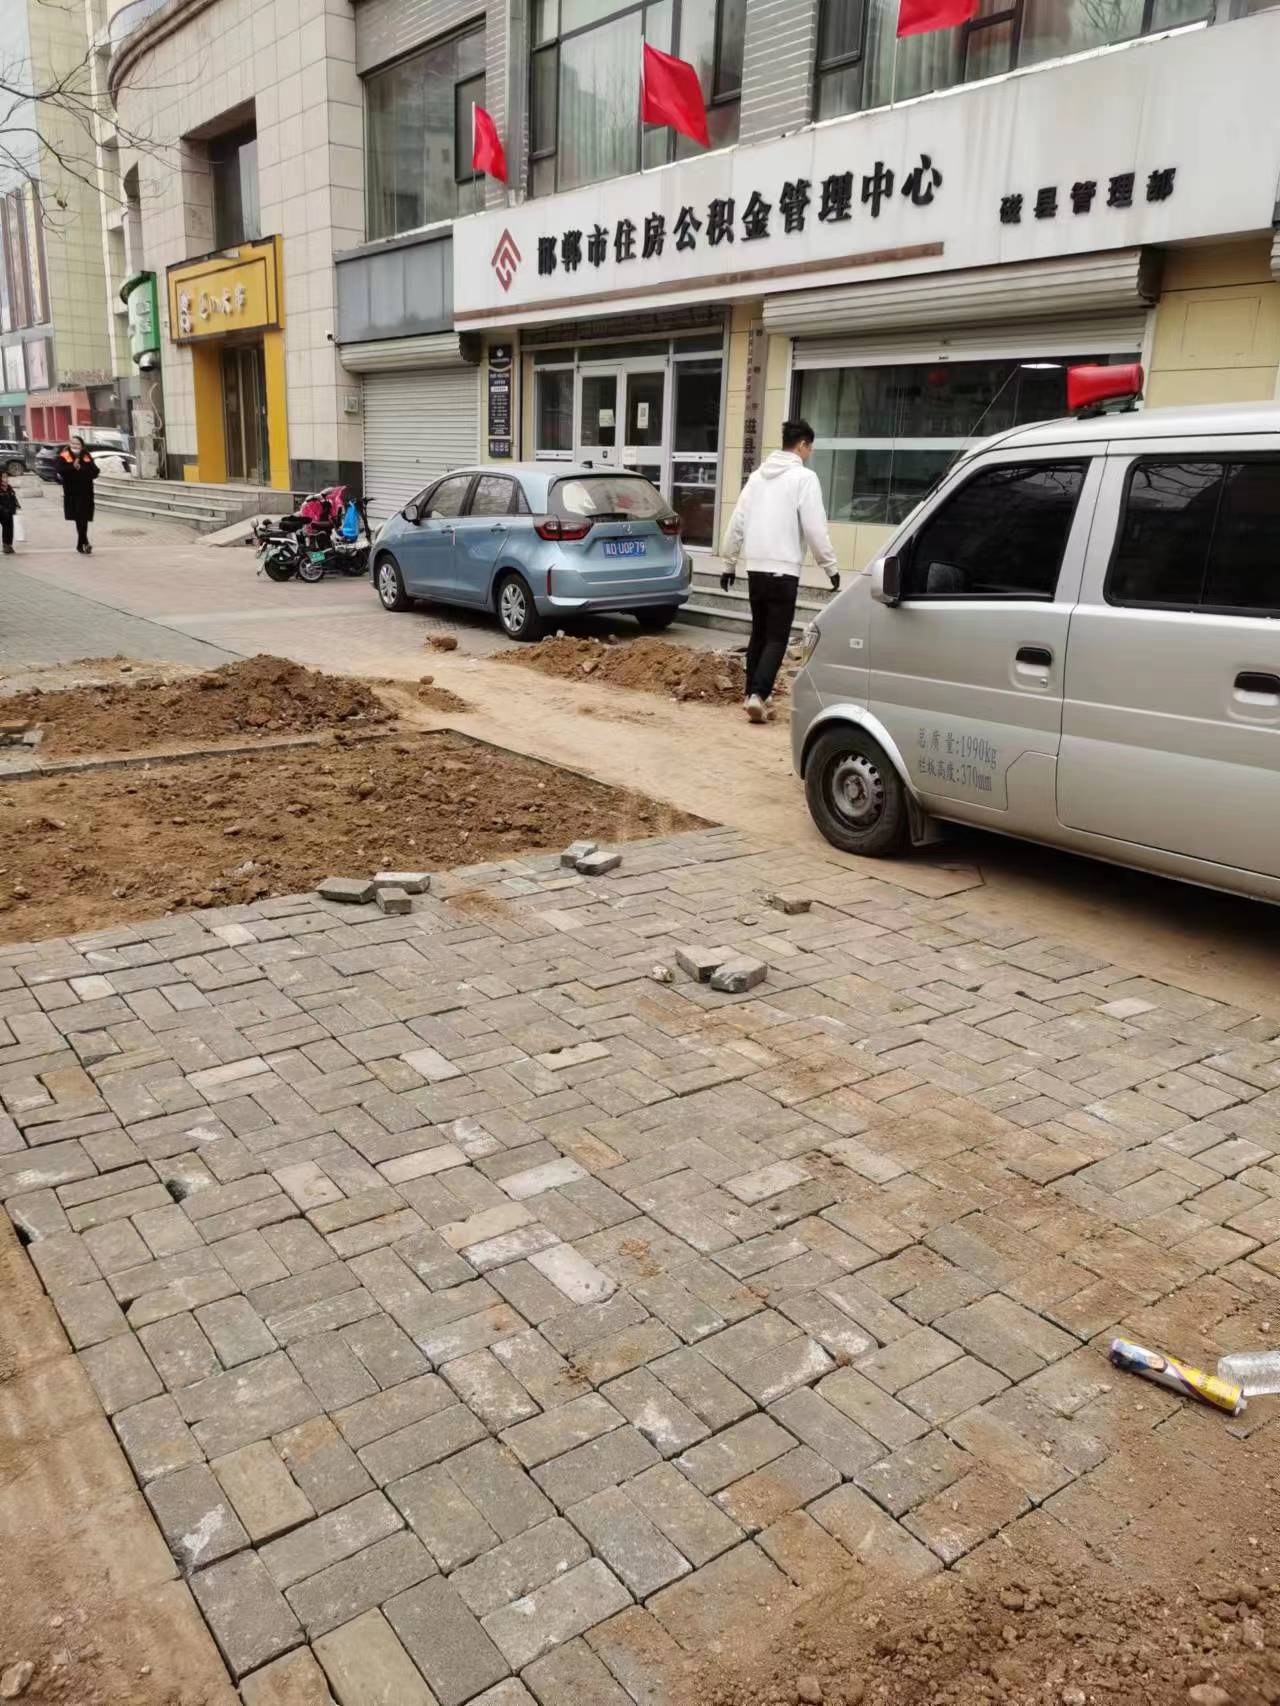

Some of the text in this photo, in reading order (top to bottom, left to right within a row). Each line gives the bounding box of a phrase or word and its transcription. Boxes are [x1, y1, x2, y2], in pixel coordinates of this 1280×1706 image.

[537, 153, 943, 276] 邯郸市住房公积金管理中心
[999, 167, 1177, 225] 磁县管理部
